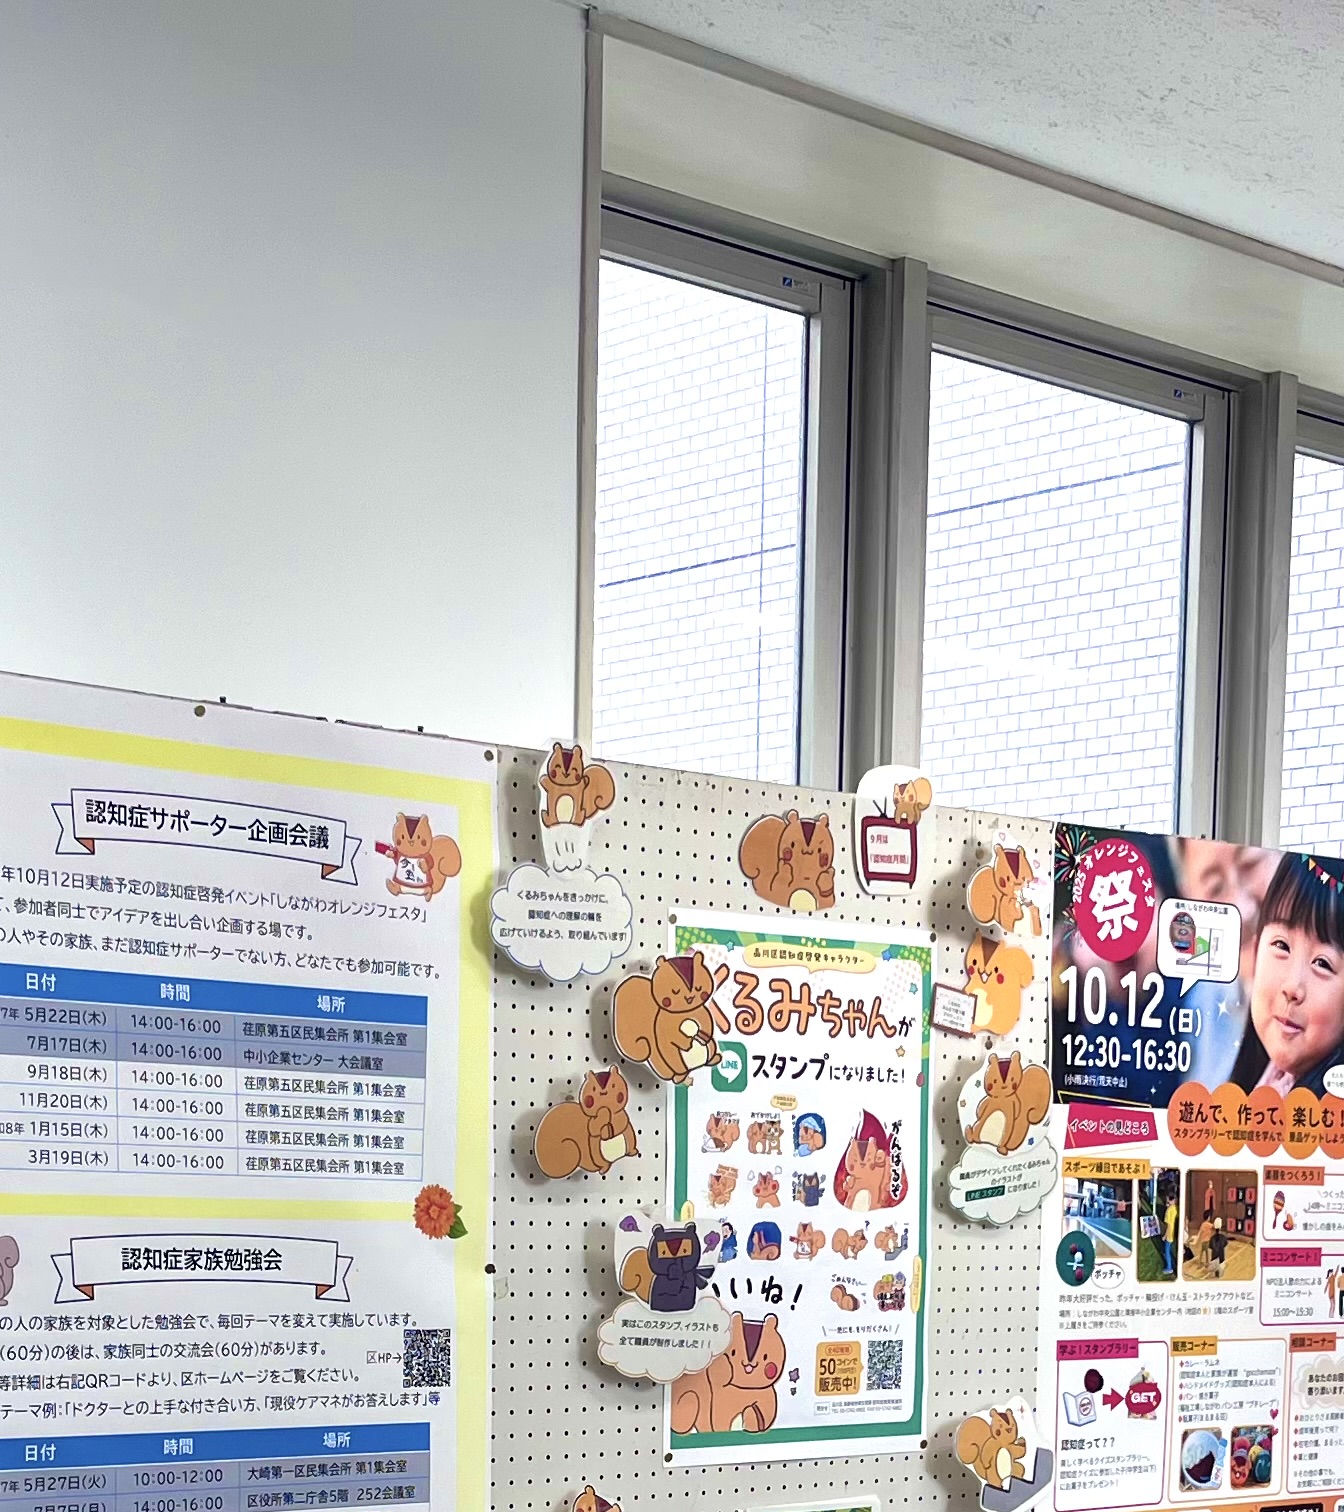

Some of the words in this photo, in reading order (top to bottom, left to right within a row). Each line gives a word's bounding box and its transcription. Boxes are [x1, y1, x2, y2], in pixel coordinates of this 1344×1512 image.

[85, 798, 329, 850] 認知症サポーター企画会議
[870, 834, 889, 845] 9月は
[1072, 870, 1087, 904] 2025
[1089, 869, 1138, 941] 祭
[25, 972, 56, 992] 日付
[160, 982, 191, 1002] 時間
[317, 995, 346, 1014] 場所
[711, 963, 916, 1039] くるみちゃんが
[1059, 965, 1165, 1029] 10.12
[1169, 1006, 1202, 1037] (日)
[24, 1007, 107, 1026] 5月22日(木)
[130, 1013, 221, 1034] 14:00-16:00
[242, 1021, 349, 1044] 荏原第五区民集会所
[353, 1030, 408, 1047] 第1集会室
[720, 1059, 739, 1070] LINE
[752, 1053, 906, 1084] スタンプになりました!
[1061, 1034, 1191, 1073] 12:30-16:30
[1069, 1117, 1150, 1136] イベントの見どころ
[889, 1119, 903, 1199] がんばるぞ
[121, 1247, 283, 1272] 認知症家族勉強会
[366, 1351, 393, 1365] 区HP
[1172, 1340, 1216, 1352] 販売コーナー
[818, 1376, 857, 1392] 販売中!
[1130, 1391, 1156, 1403] GET
[25, 1443, 56, 1462] 日付
[163, 1438, 193, 1456] 時間
[323, 1432, 351, 1449] 場所
